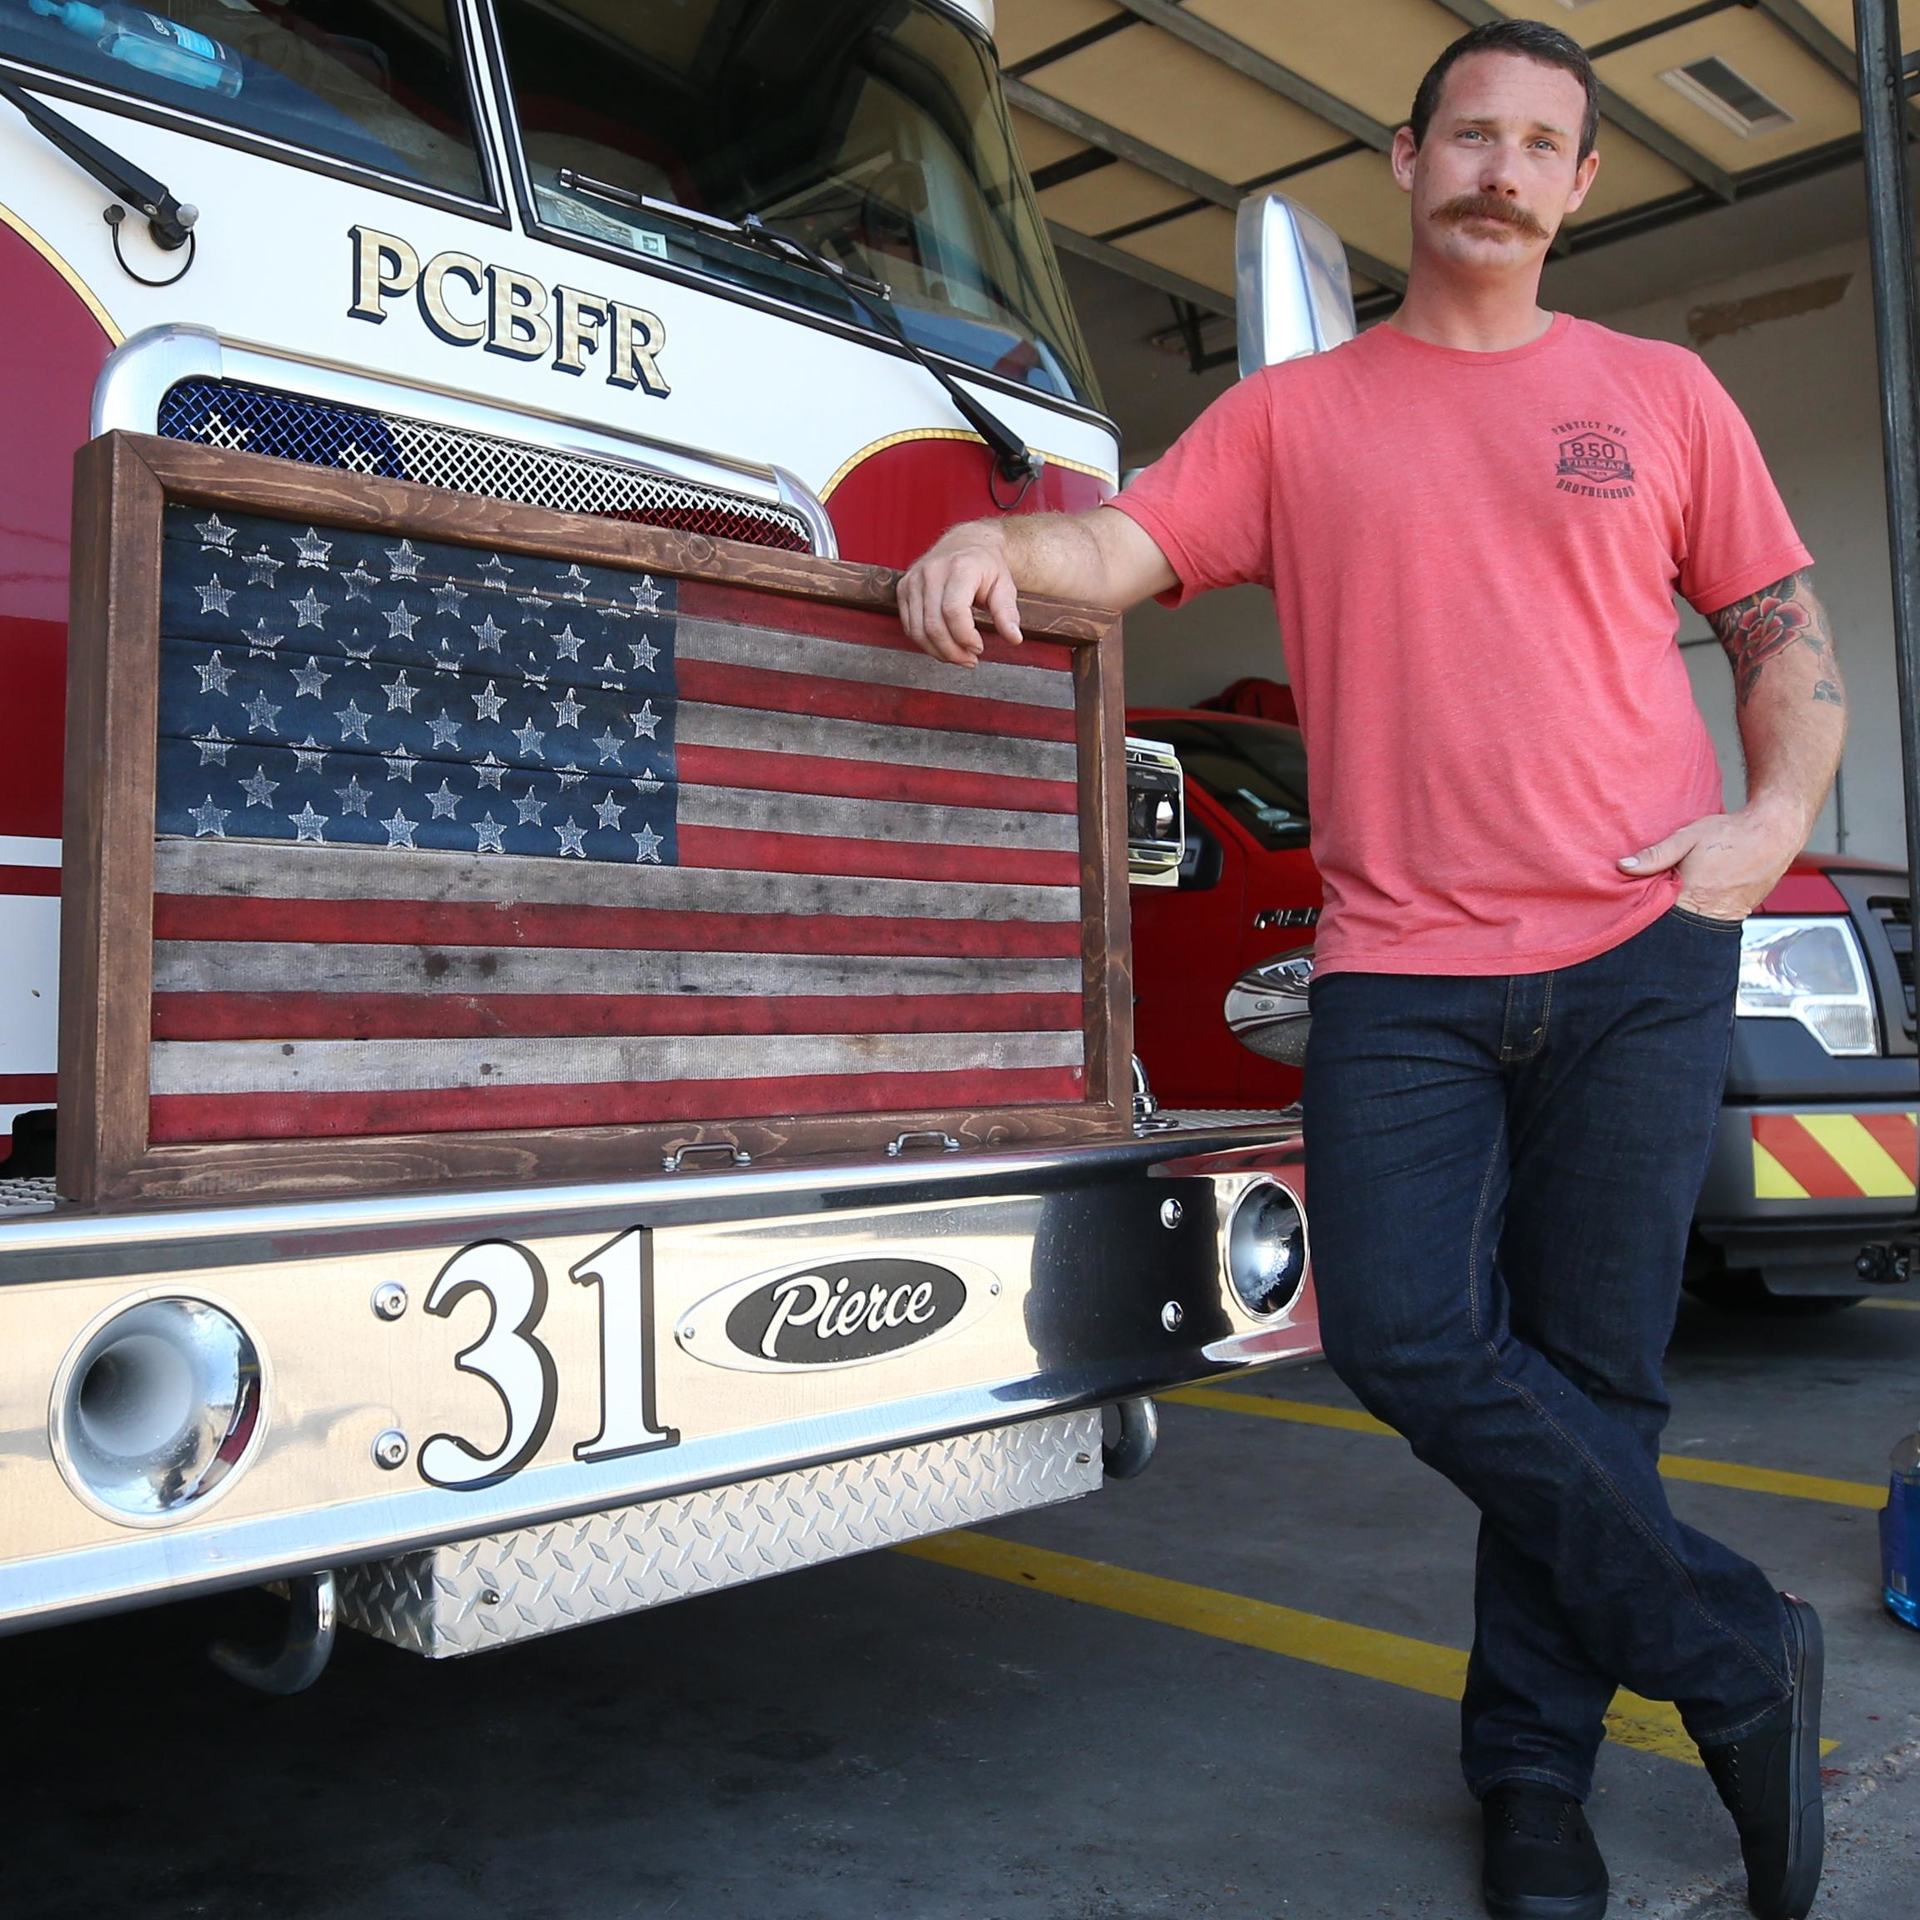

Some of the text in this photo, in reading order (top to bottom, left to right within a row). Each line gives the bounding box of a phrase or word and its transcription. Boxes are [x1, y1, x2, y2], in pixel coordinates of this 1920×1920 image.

[347, 224, 671, 399] PCBFR
[1551, 421, 1627, 437] PROTECT THE
[1571, 442, 1616, 459] 850
[1556, 479, 1636, 499] BROTHERHOOD
[759, 1275, 937, 1358] Pierce
[417, 1225, 681, 1492] 31
